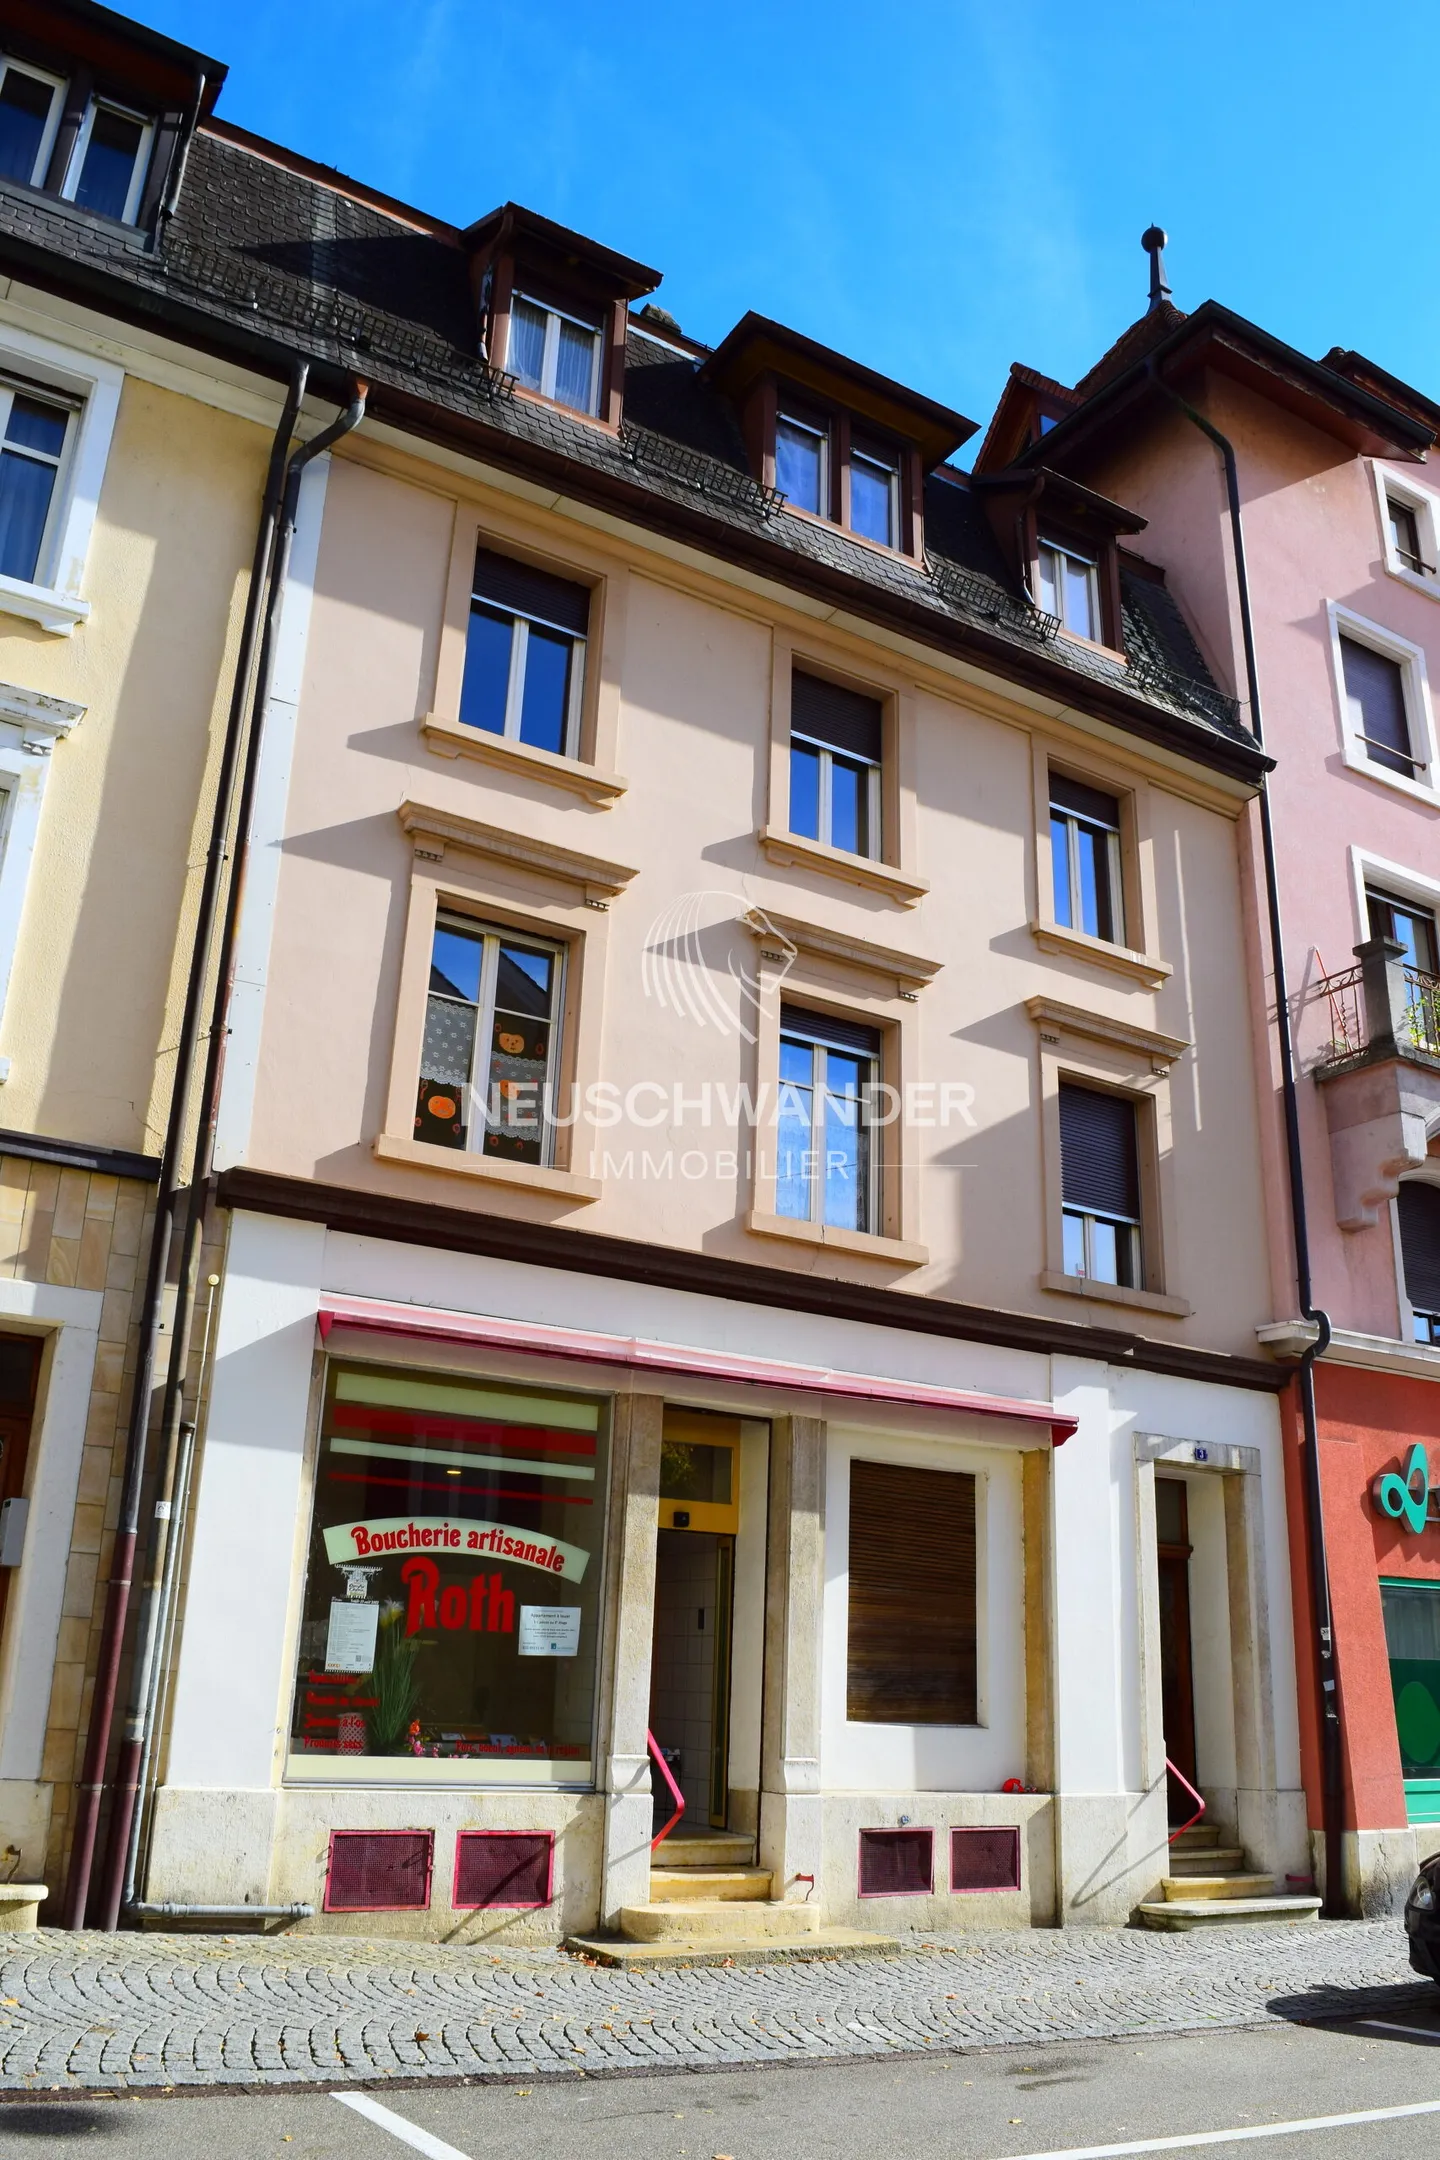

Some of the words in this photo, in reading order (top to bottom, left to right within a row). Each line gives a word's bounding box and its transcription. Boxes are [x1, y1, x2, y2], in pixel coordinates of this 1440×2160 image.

[351, 1522, 461, 1556] Boucherie
[467, 1527, 566, 1573] artisanale
[401, 1556, 515, 1638] Roth
